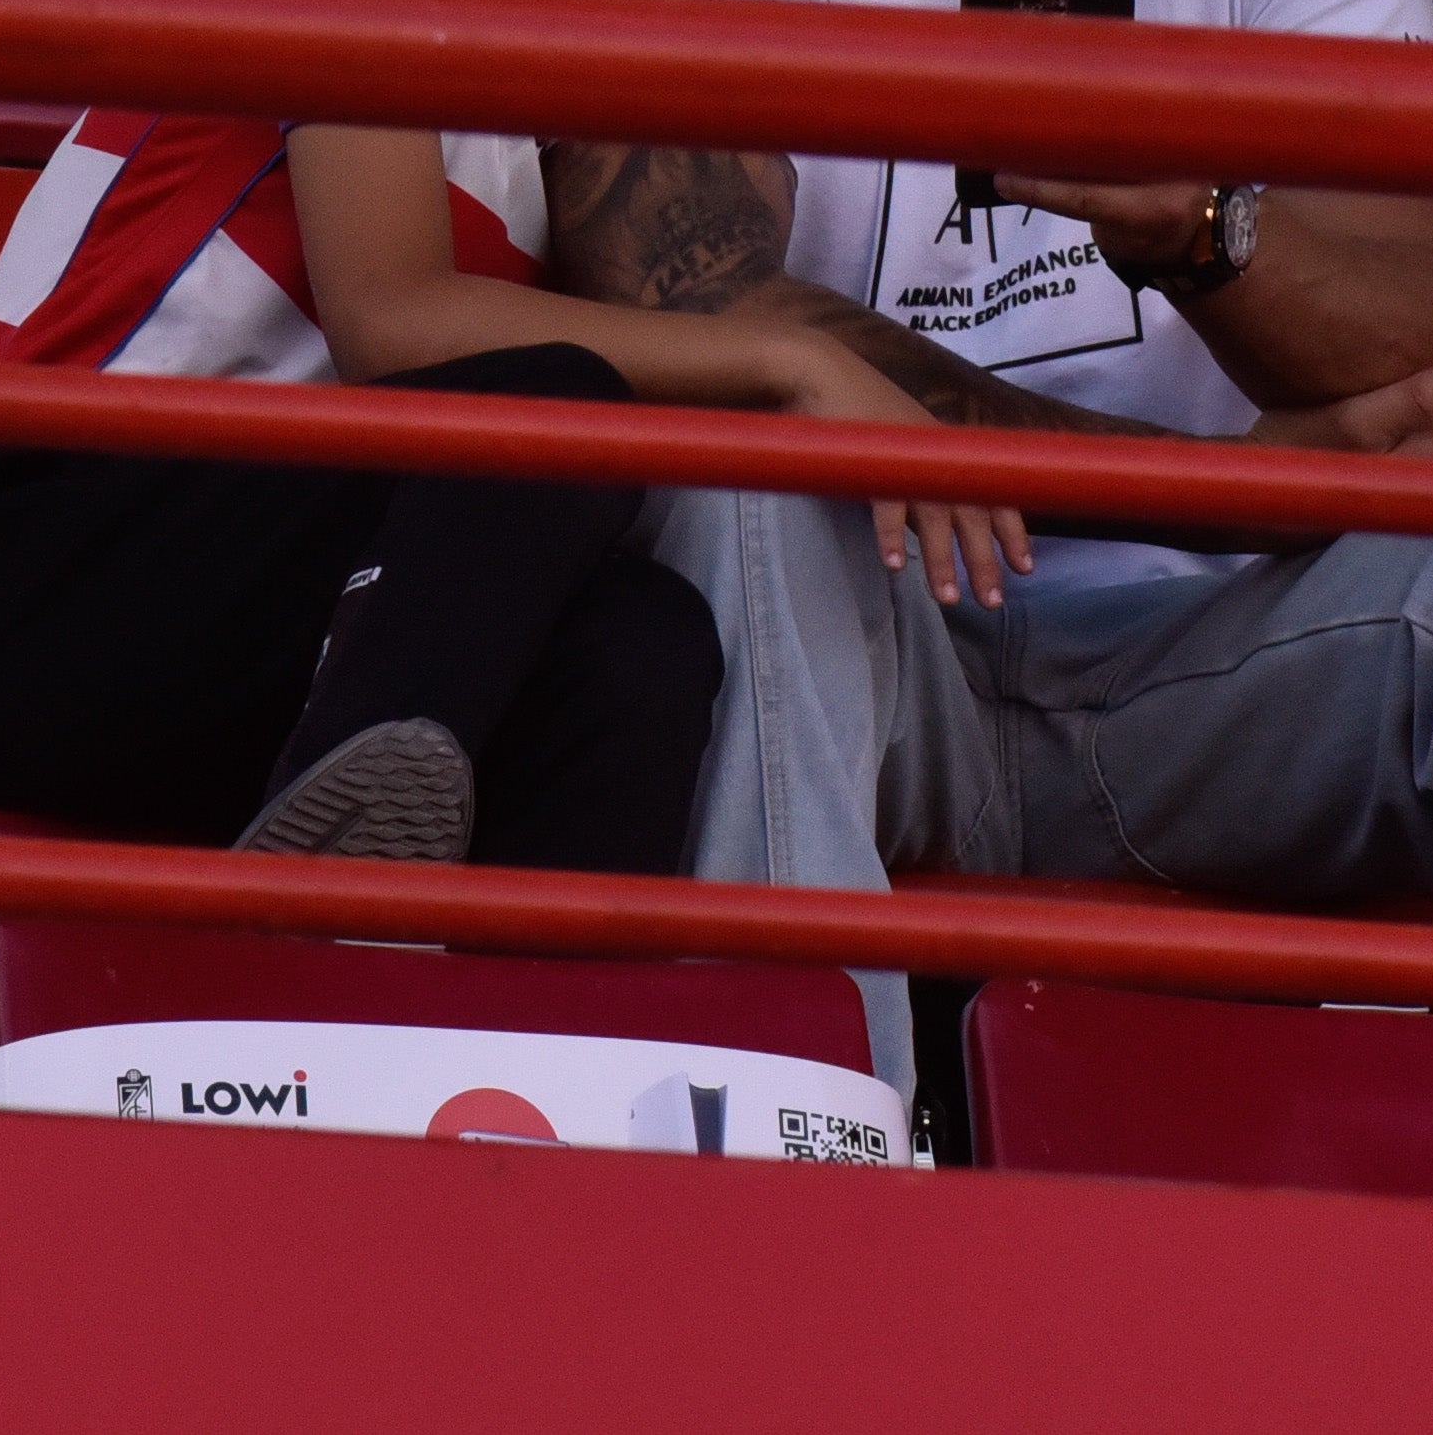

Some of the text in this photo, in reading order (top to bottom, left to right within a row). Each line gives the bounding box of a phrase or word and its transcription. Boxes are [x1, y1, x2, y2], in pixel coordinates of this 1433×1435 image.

[896, 241, 1100, 307] ARMANI EXCHANGE
[909, 315, 971, 332] BLACK
